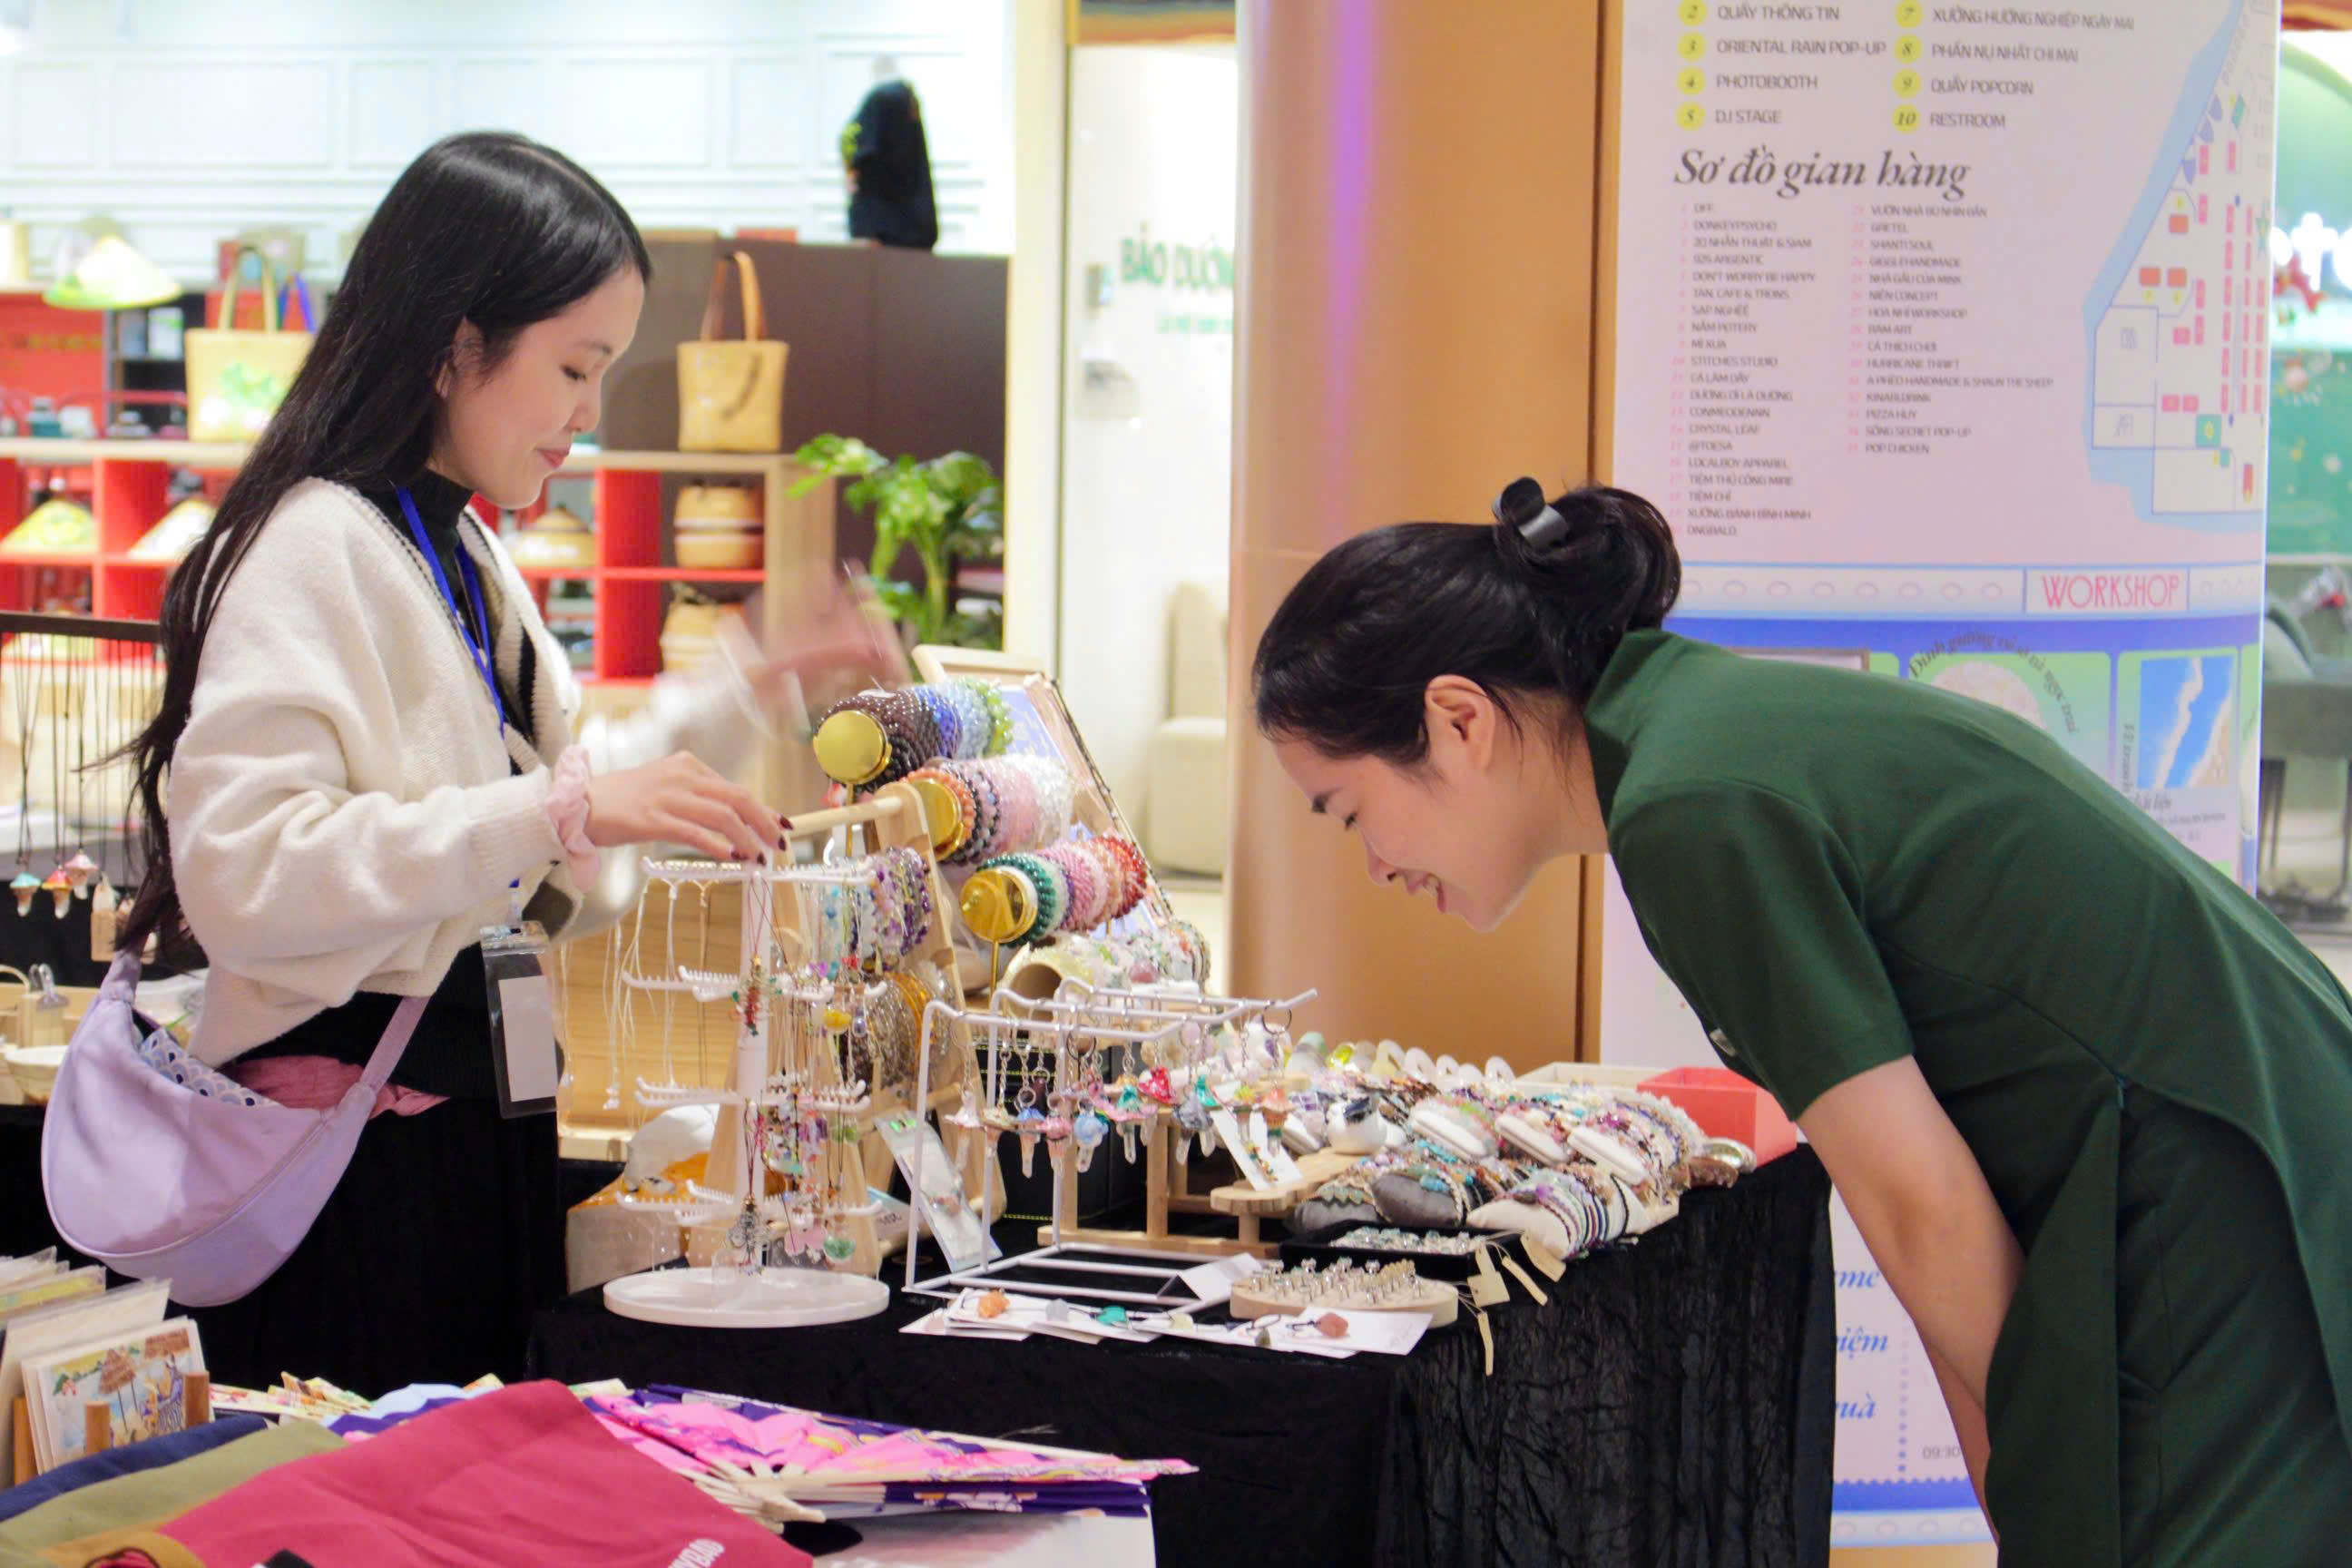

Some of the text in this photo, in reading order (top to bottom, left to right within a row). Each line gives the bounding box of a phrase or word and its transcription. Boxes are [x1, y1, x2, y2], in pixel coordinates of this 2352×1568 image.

[1761, 4, 1813, 20] THÔNG
[1817, 6, 1840, 20] TIN
[1716, 40, 1788, 54] ORIENTAL
[1791, 41, 1826, 54] RAIN
[1829, 41, 1886, 55] POP-UP
[1715, 74, 1818, 89] PHOTOBOOTH
[1970, 80, 2034, 95] POPCORN
[1715, 109, 1732, 123] DJ
[1736, 109, 1781, 123] STAGE
[1897, 111, 2006, 128] 10 RESTROOM
[1674, 143, 1971, 201] Sơ đồ gian hàng
[2041, 574, 2180, 609] WORKSHOP
[1834, 1270, 1881, 1289] me
[1836, 1325, 1888, 1360] iệm
[1835, 1391, 1877, 1420] uà
